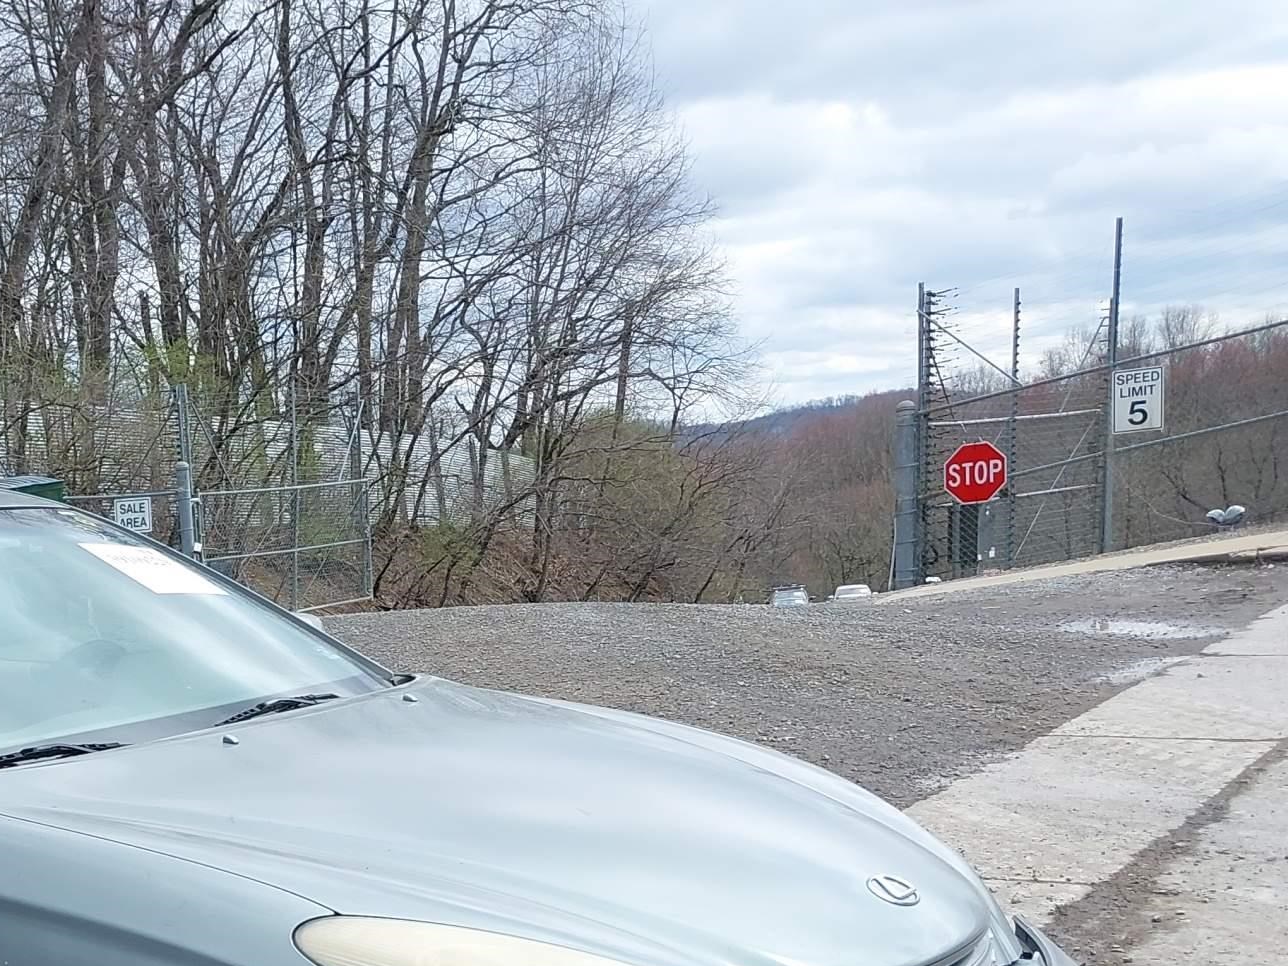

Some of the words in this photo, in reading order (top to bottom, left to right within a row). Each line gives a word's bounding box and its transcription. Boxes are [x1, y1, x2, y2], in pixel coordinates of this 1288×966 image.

[1116, 371, 1160, 385] SPEED
[1119, 384, 1156, 399] LIMIT
[1127, 400, 1148, 426] 5
[947, 458, 1003, 488] STOP
[119, 502, 145, 515] SALE
[120, 517, 147, 528] AREA
